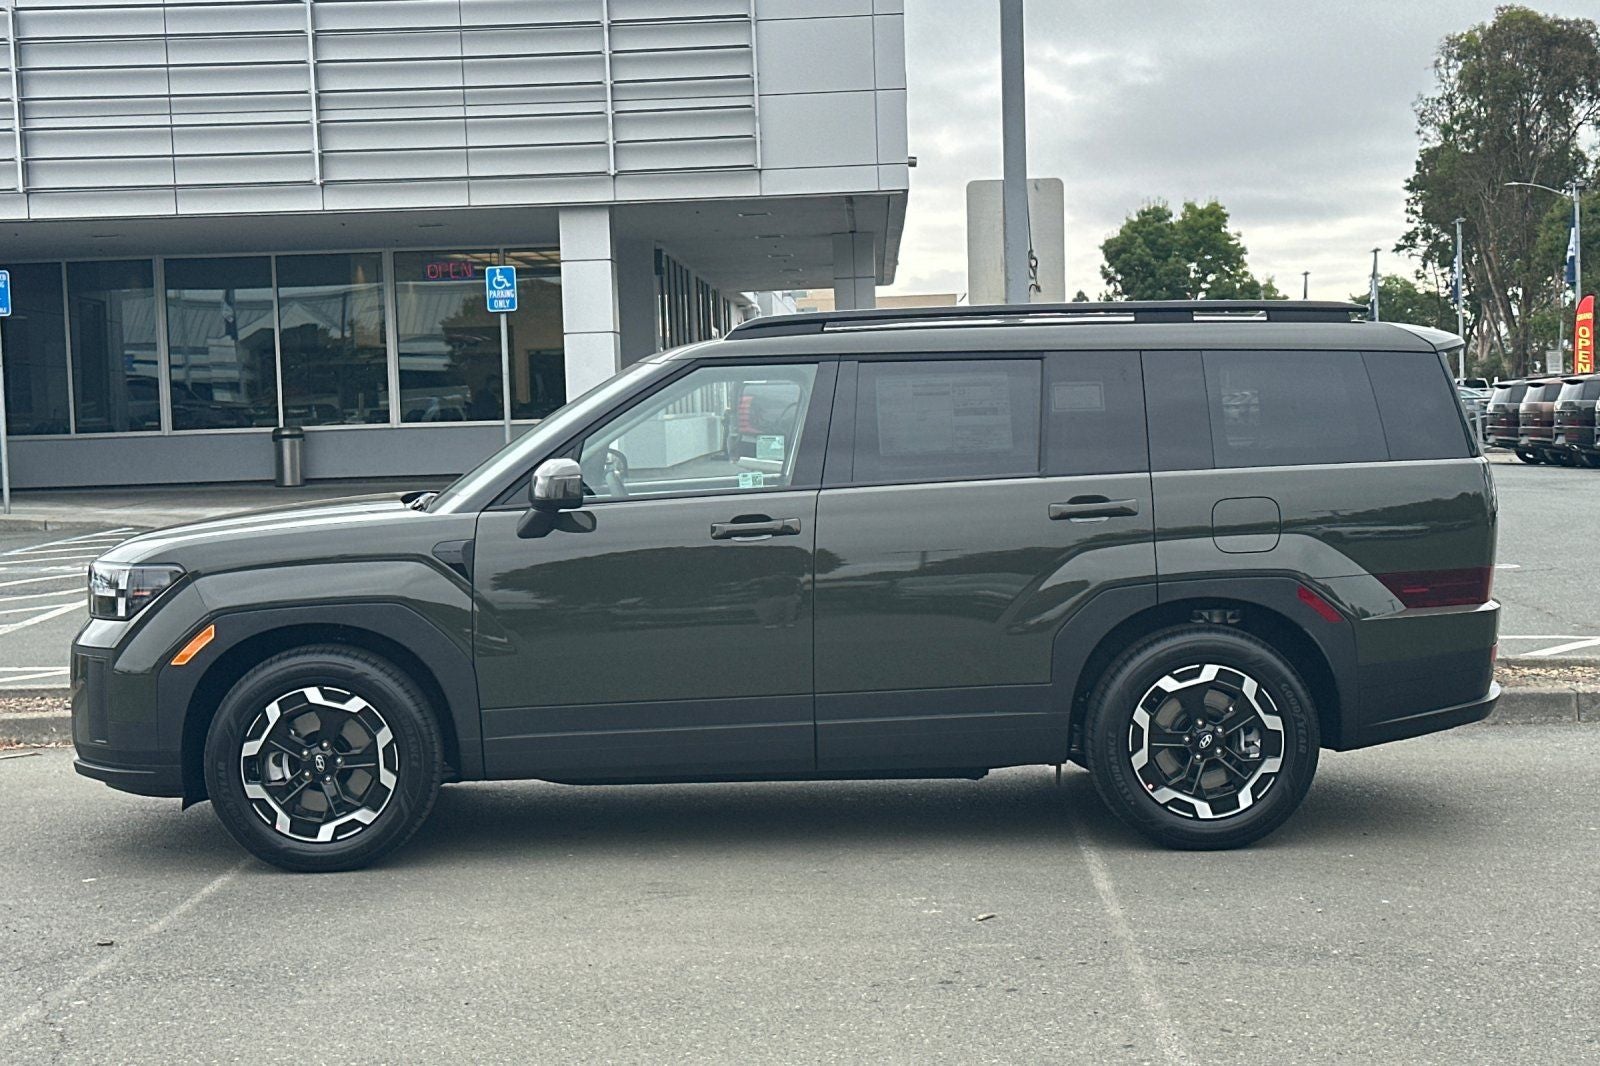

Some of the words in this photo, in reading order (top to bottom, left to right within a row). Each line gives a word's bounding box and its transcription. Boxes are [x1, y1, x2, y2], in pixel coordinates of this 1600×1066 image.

[426, 262, 472, 279] OPEN
[489, 289, 515, 299] PARKING
[493, 299, 510, 309] ONLY
[1577, 326, 1591, 374] OPEN
[1281, 683, 1307, 754] GOODYEAR
